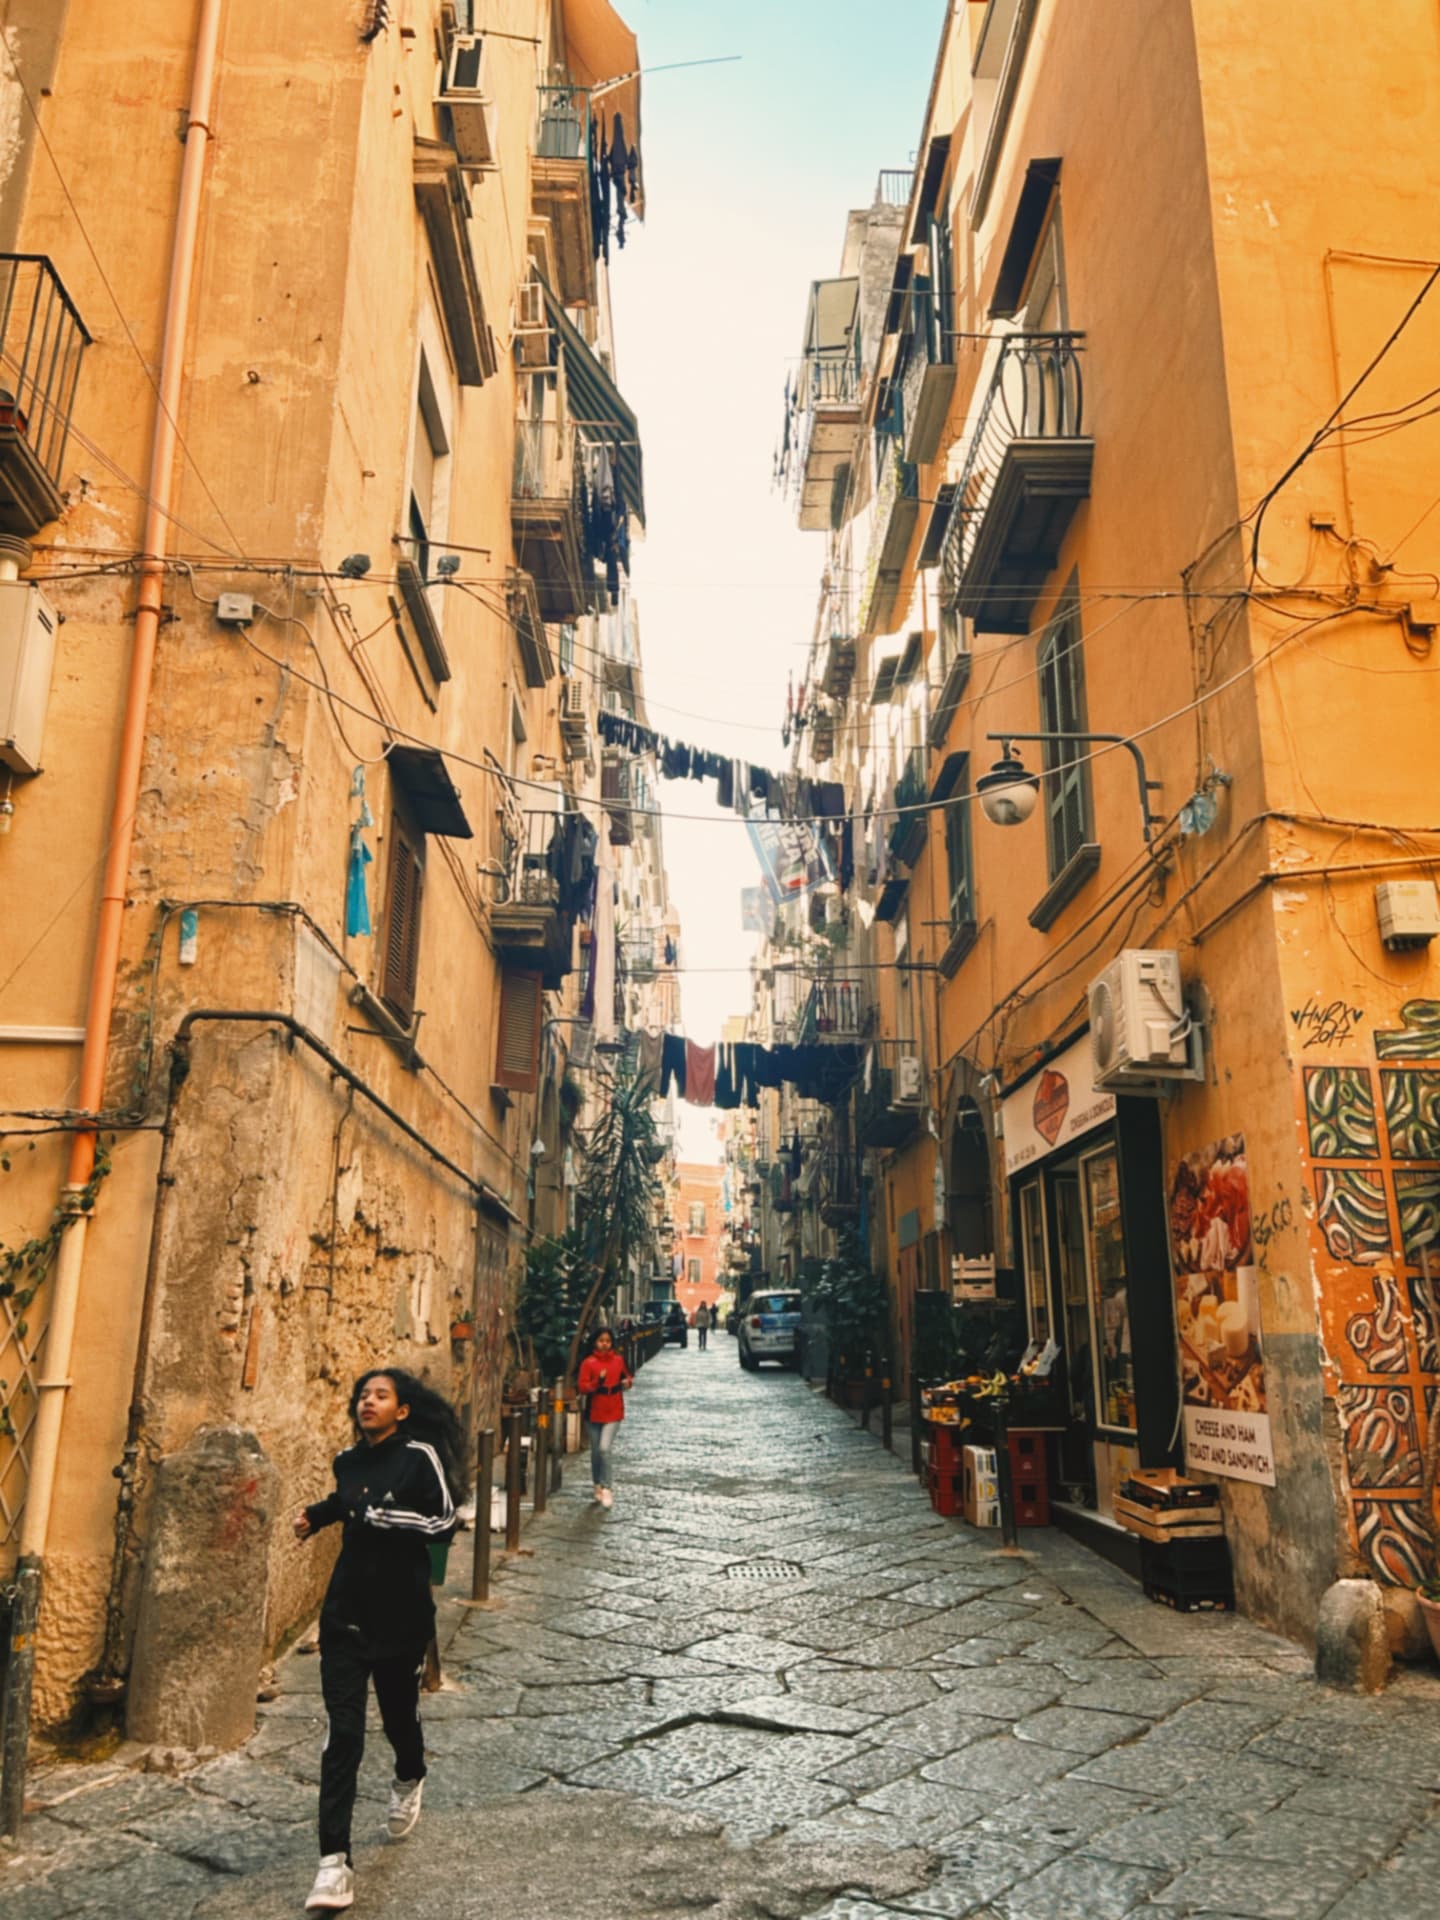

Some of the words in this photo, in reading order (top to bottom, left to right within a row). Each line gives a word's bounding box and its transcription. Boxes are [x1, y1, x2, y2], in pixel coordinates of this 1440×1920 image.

[1302, 1024, 1354, 1050] 2017
[1195, 1418, 1220, 1438] CHEESE
[1220, 1423, 1236, 1441] AND
[1237, 1424, 1256, 1444] HAM
[1189, 1442, 1210, 1461] TOAST
[1211, 1447, 1226, 1465] AND
